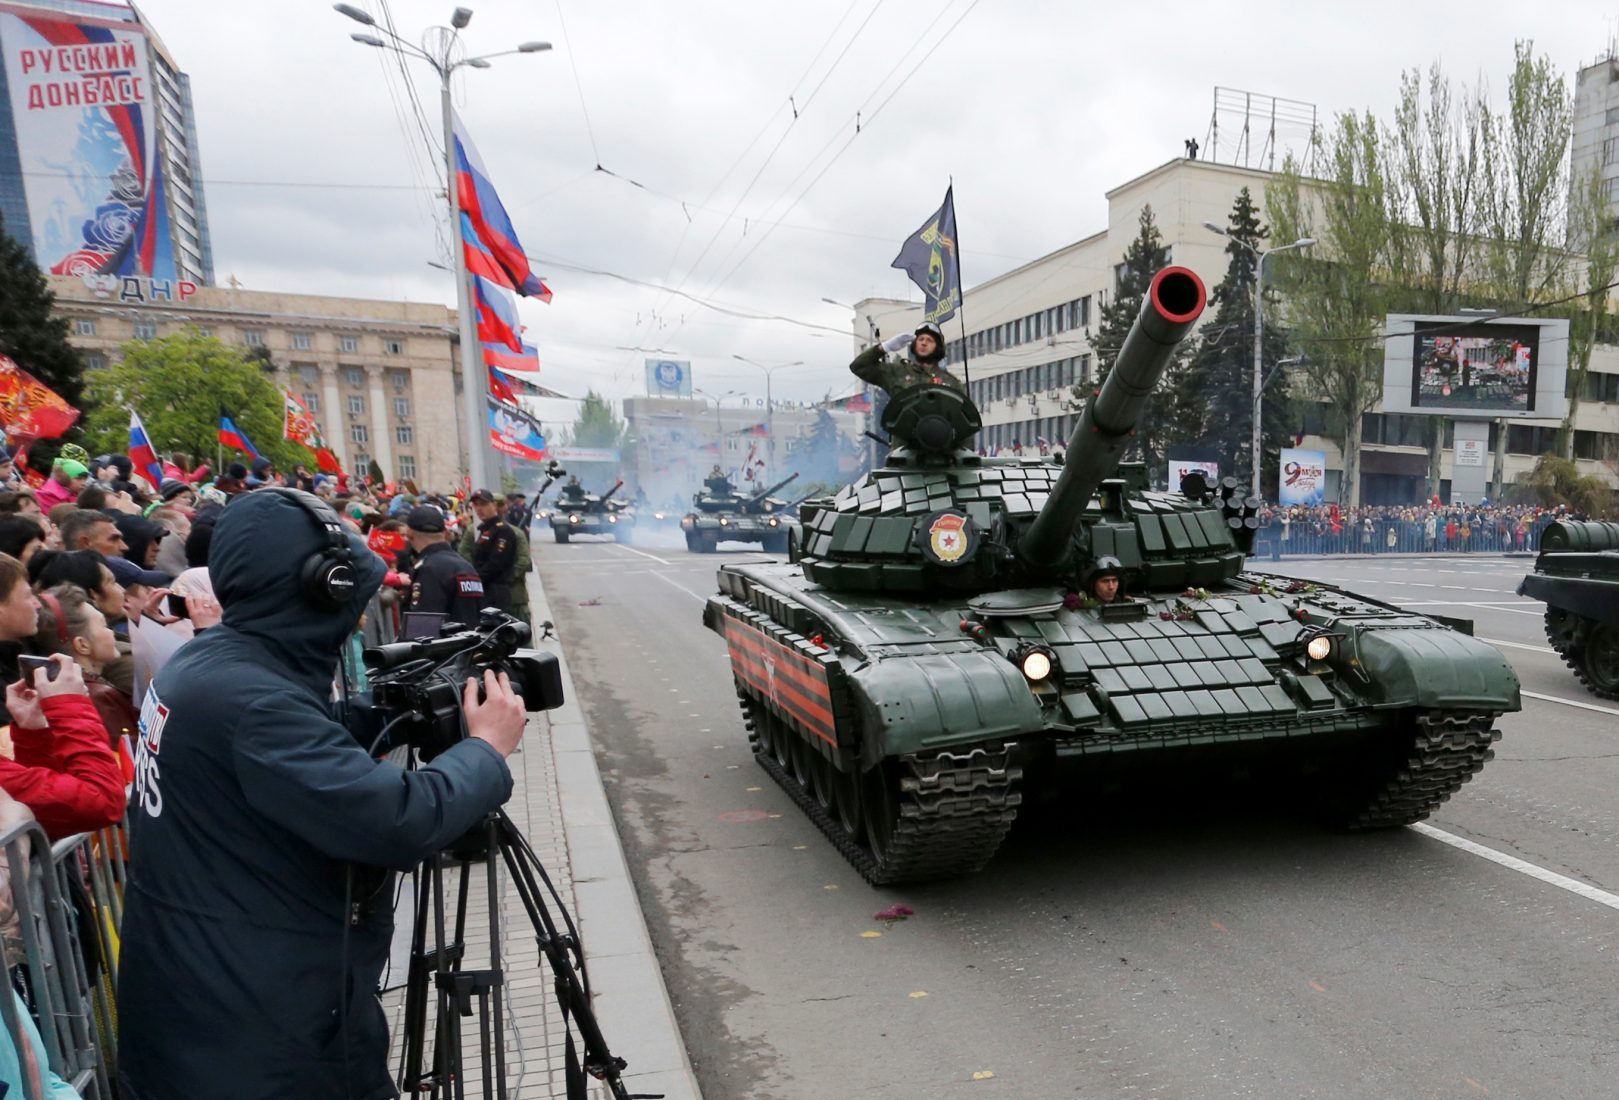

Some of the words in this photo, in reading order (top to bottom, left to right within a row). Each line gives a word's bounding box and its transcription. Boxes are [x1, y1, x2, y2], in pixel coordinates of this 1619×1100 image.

[20, 40, 136, 74] РУССКИЙ
[28, 77, 144, 110] ДОНБАСС
[120, 277, 197, 302] ДНР
[1284, 461, 1302, 487] 9
